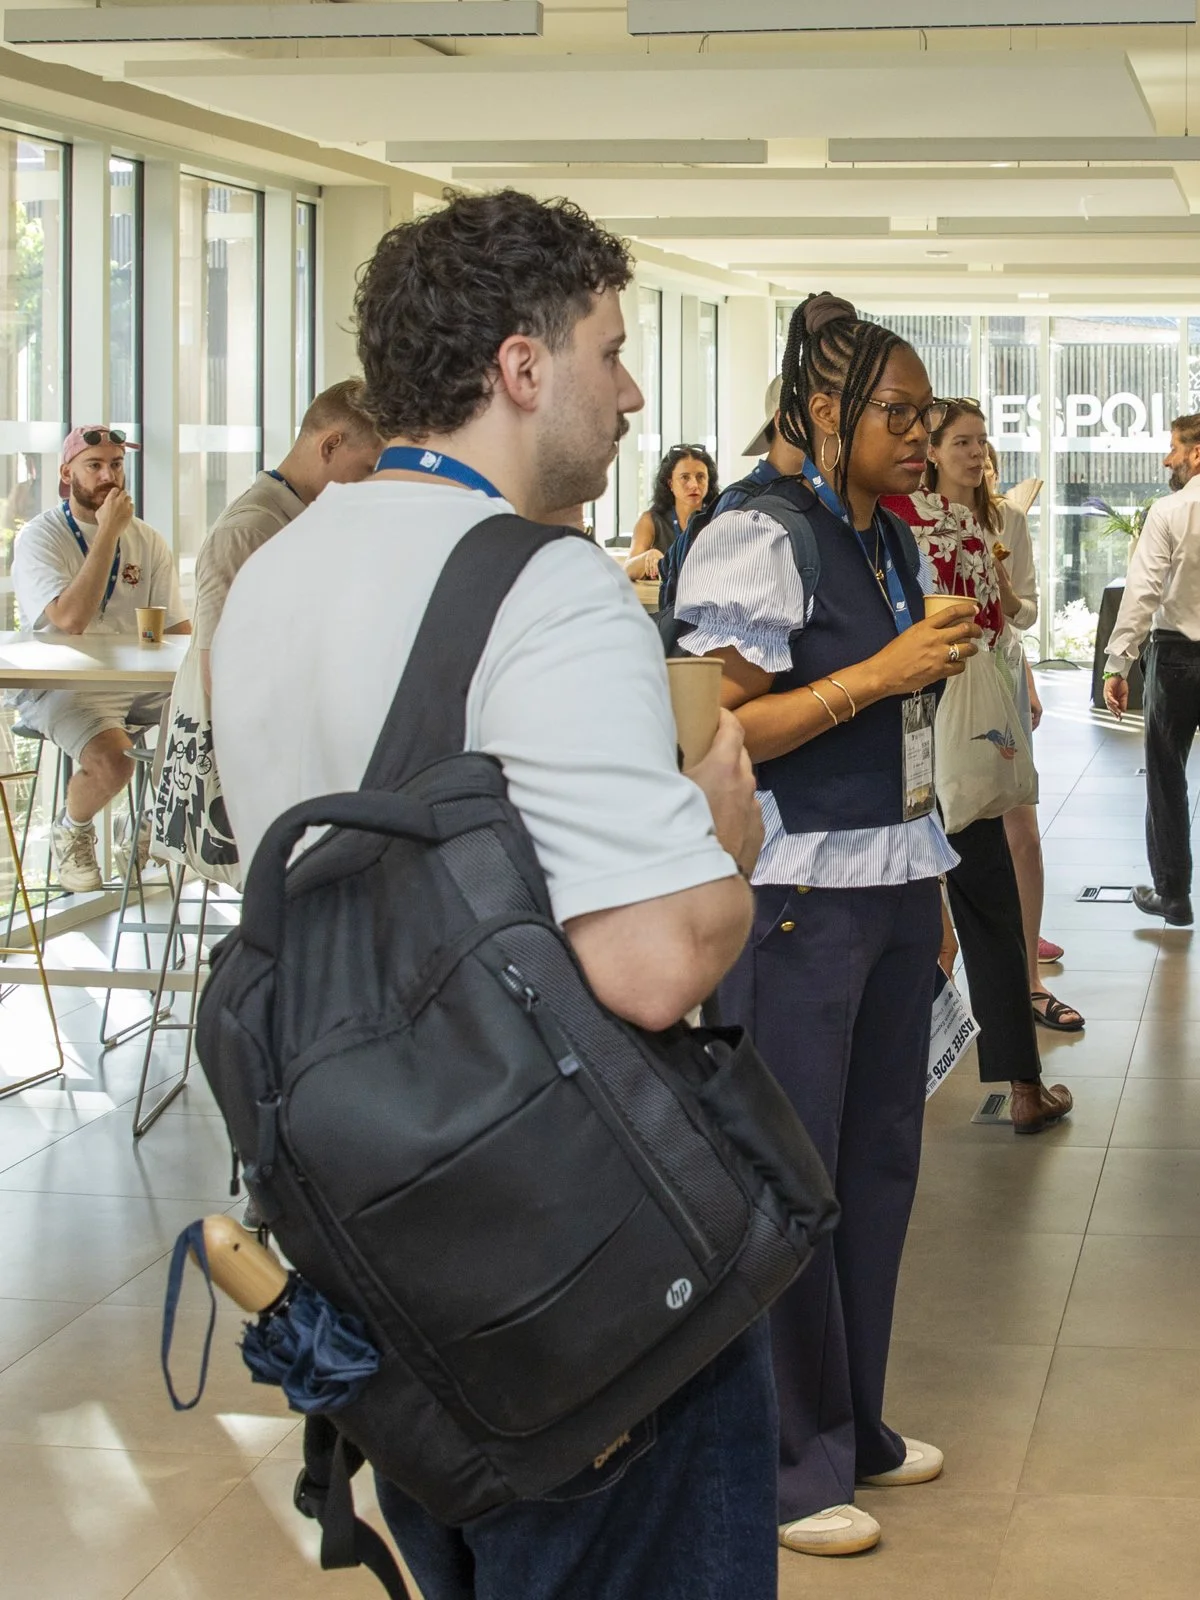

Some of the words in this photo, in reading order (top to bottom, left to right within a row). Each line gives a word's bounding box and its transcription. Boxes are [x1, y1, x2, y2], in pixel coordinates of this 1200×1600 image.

[156, 766, 172, 844] KAFFA
[952, 1018, 975, 1053] ASFEE
[932, 1047, 955, 1079] 2026
[668, 1279, 690, 1308] hp
